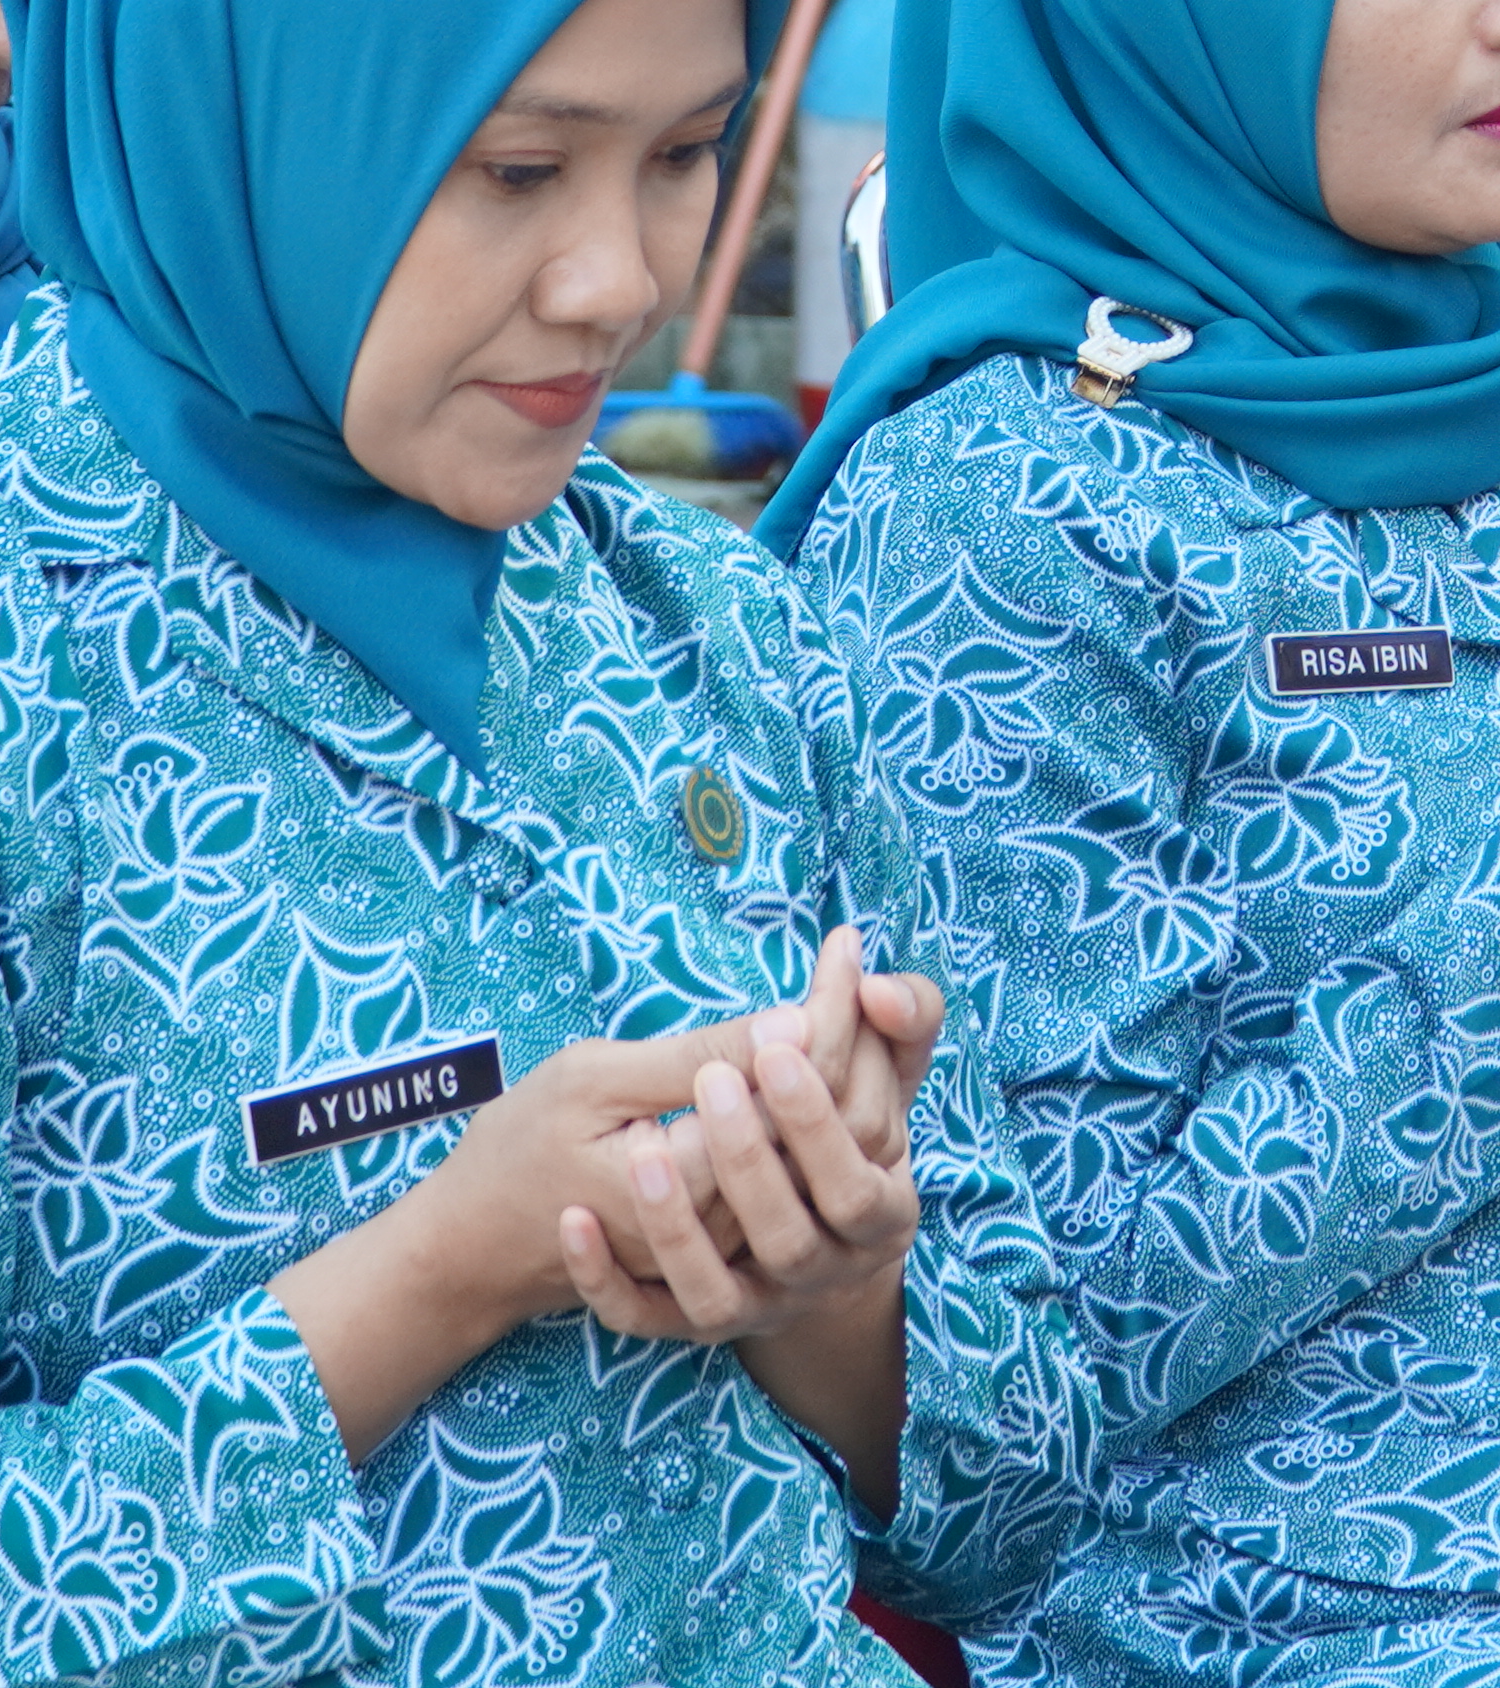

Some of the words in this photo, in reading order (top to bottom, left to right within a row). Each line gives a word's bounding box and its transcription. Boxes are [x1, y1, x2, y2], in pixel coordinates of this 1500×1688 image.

[1301, 646, 1366, 677] RISA
[1372, 644, 1429, 674] IBIN
[297, 1064, 459, 1137] AYUNING
